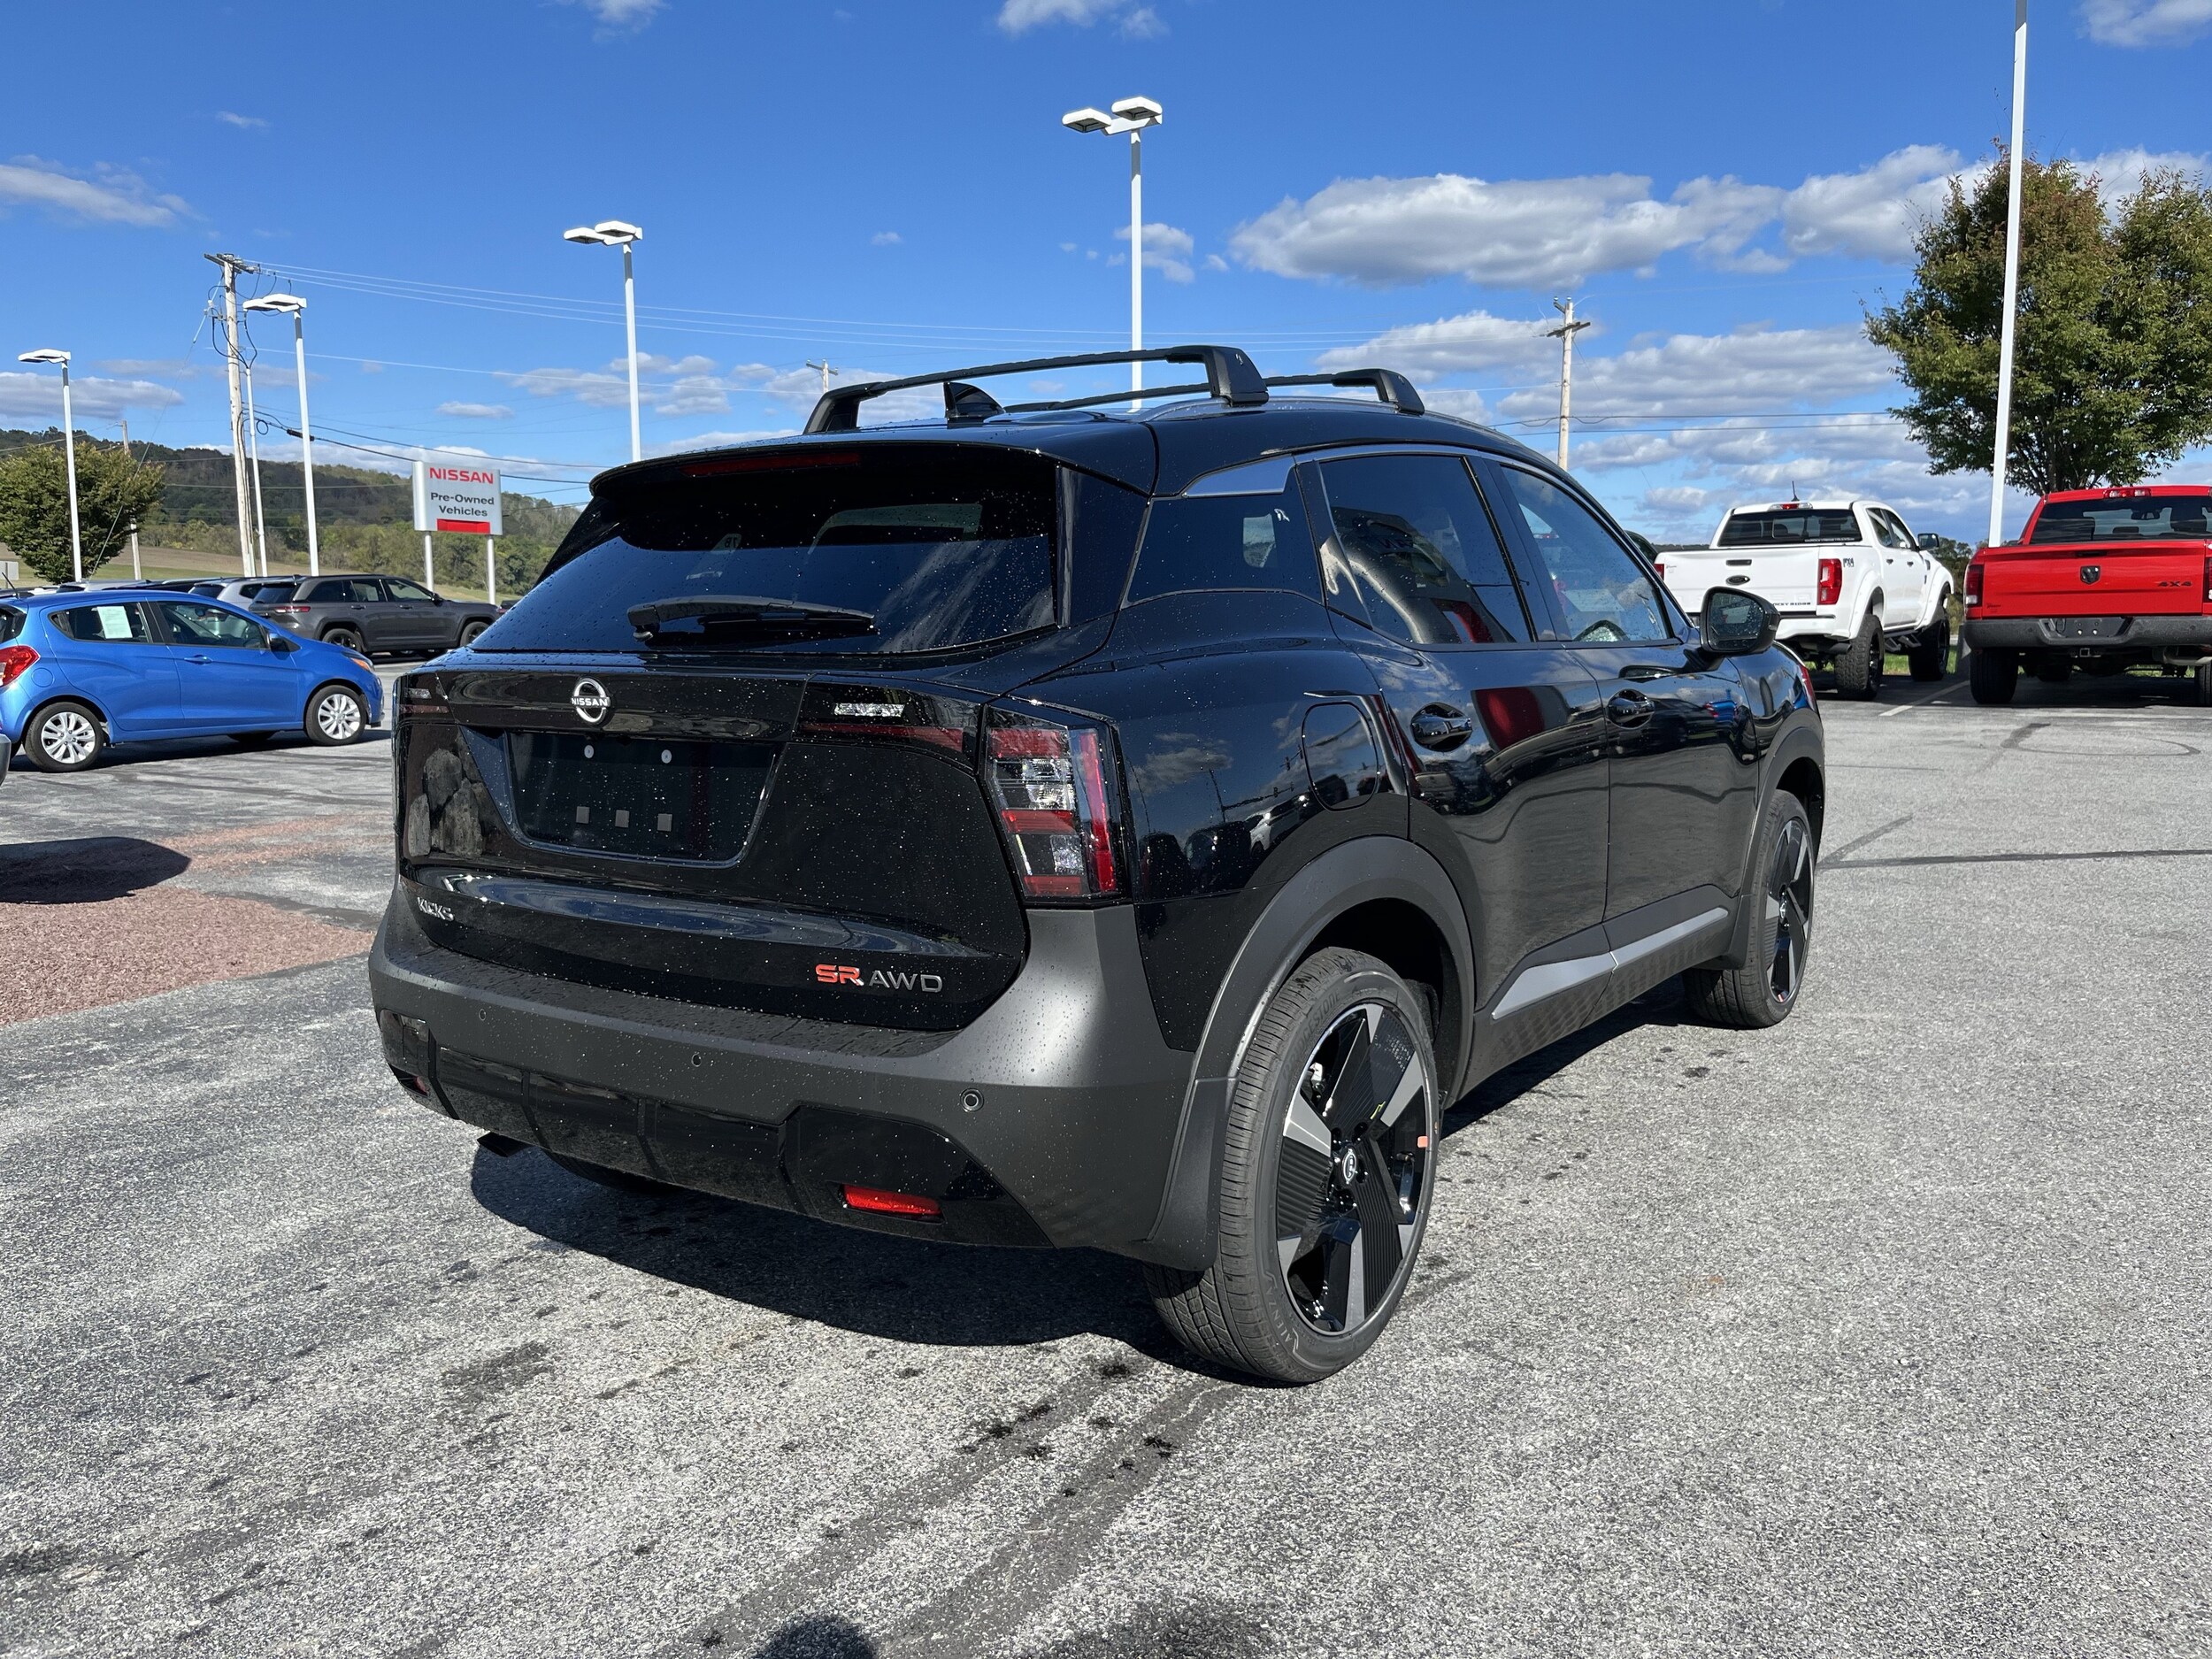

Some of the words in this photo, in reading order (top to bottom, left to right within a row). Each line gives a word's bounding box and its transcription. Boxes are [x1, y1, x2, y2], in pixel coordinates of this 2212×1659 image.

[429, 467, 494, 485] NISSAN
[430, 492, 495, 505] Pre-Owned
[439, 505, 488, 517] Vehicles
[571, 697, 608, 707] NISSAN
[417, 896, 454, 922] KICKS
[815, 964, 864, 987] SR
[869, 970, 943, 993] AWD
[1265, 1286, 1294, 1342] ALENZA
